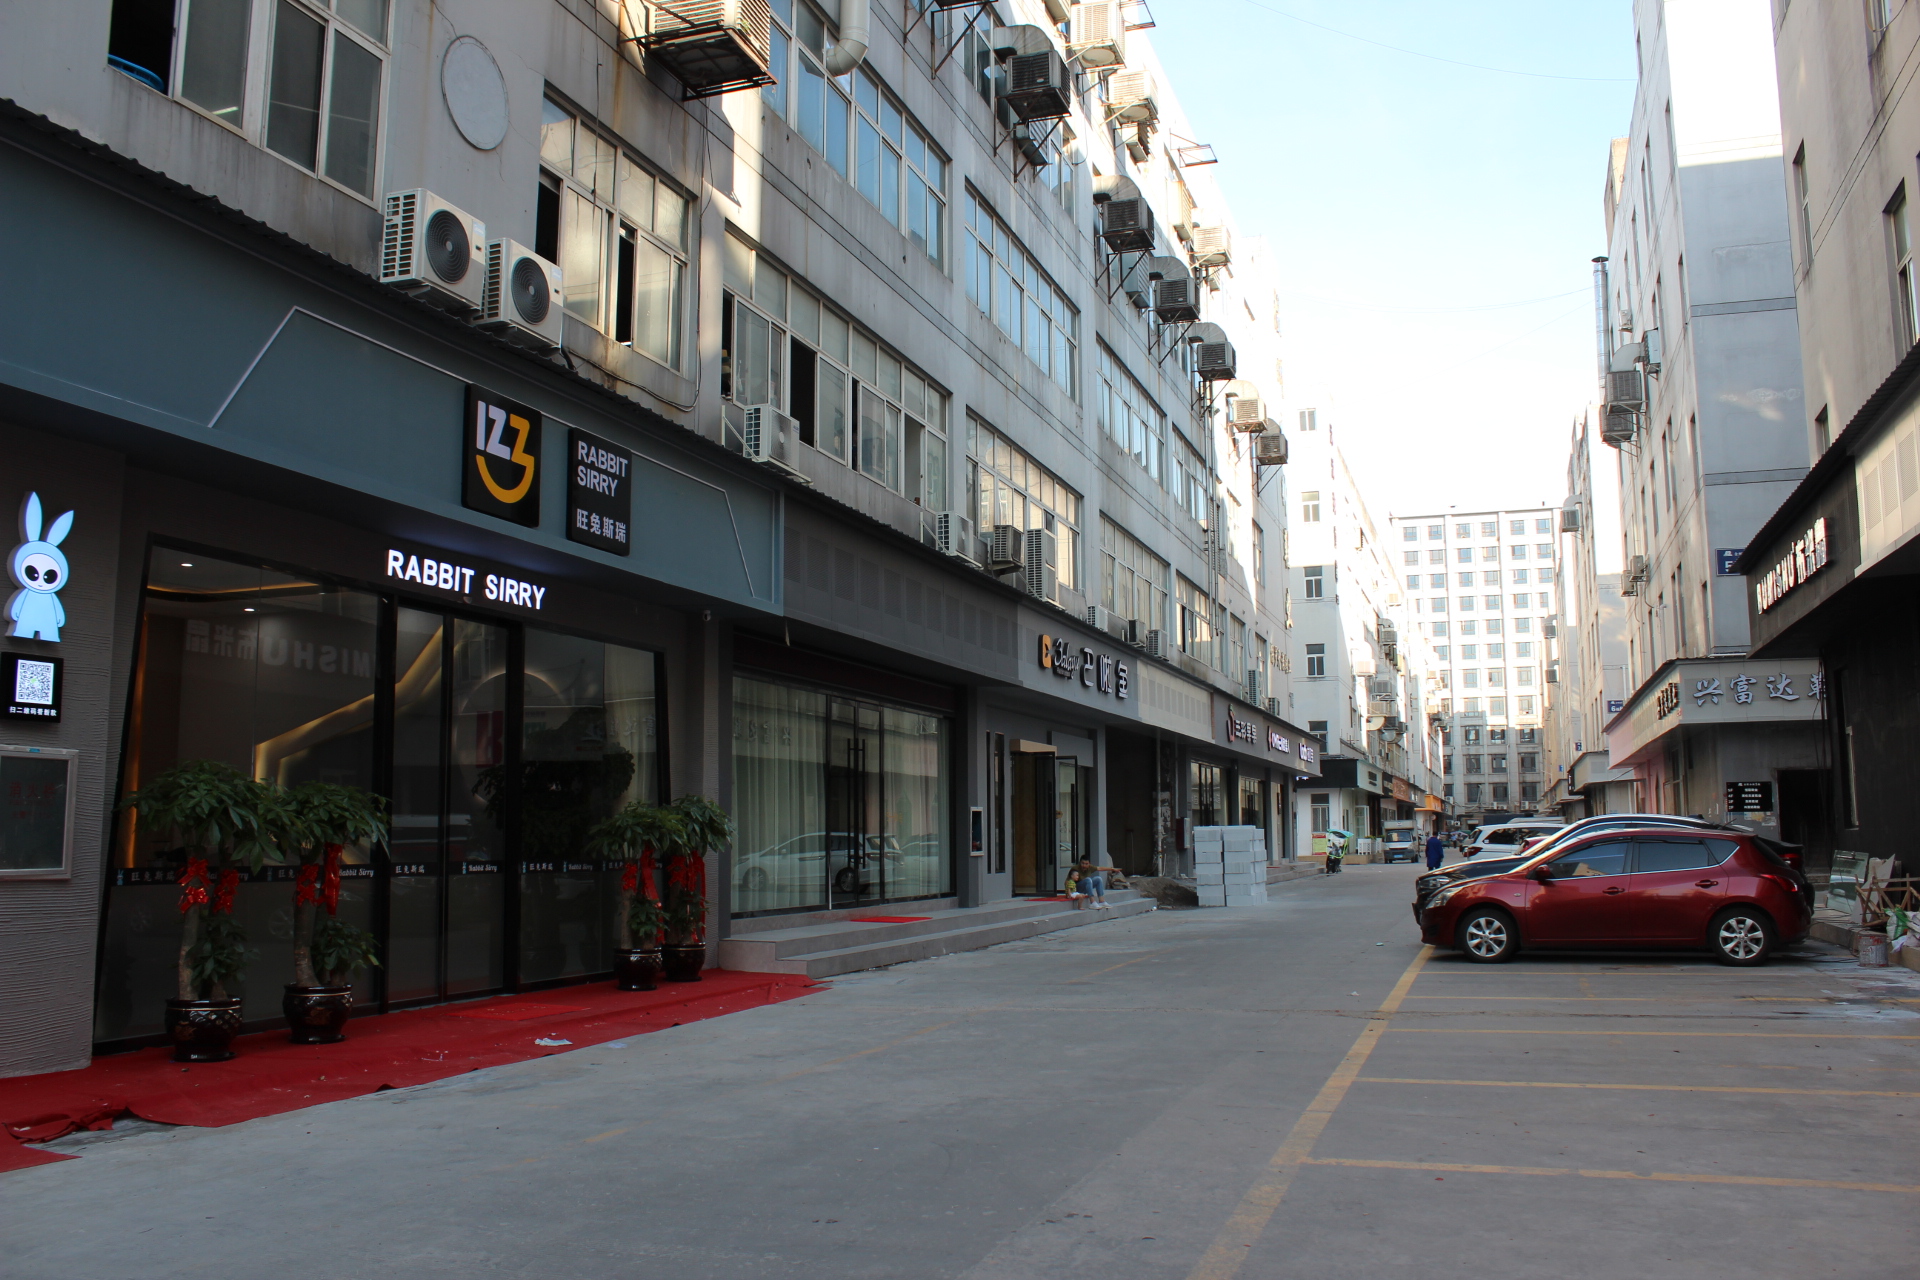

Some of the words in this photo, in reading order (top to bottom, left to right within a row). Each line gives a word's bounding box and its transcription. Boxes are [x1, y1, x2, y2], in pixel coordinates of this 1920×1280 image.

[577, 440, 629, 478] RABBIT
[577, 465, 618, 497] SIRRY
[576, 508, 627, 544] 旺兔斯瑞
[387, 549, 475, 595] RABBIT
[485, 573, 546, 610] SIRRY
